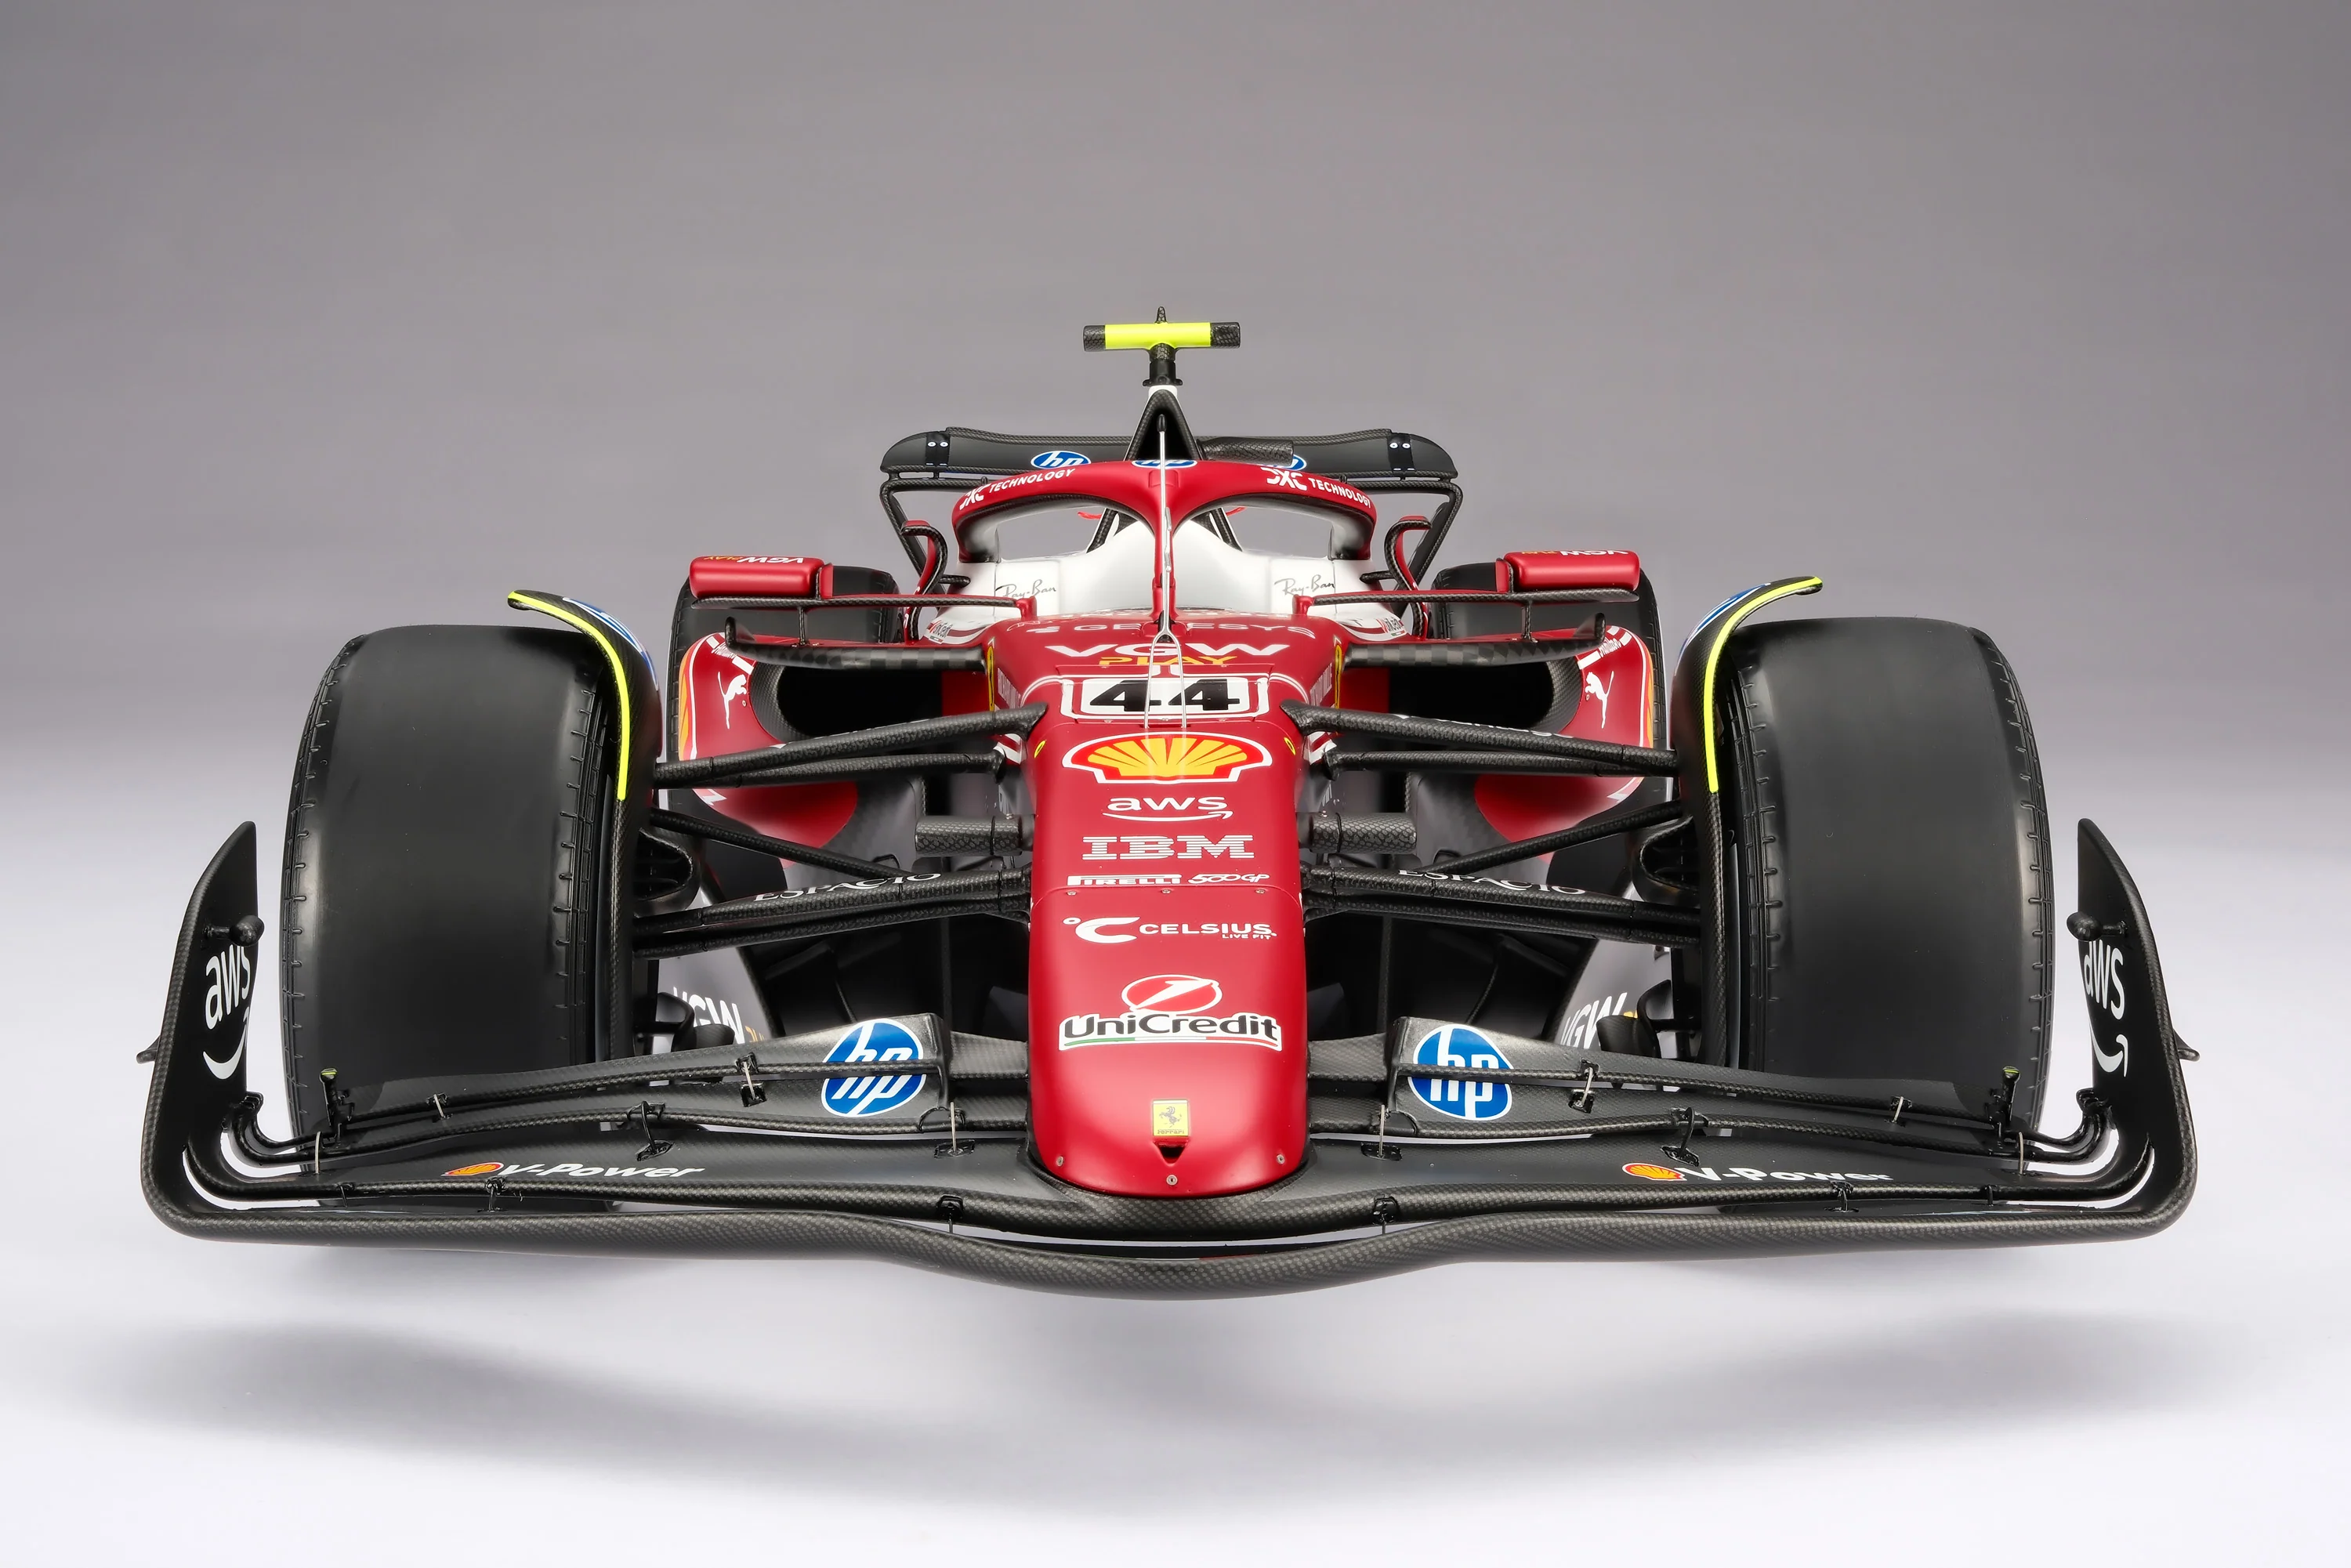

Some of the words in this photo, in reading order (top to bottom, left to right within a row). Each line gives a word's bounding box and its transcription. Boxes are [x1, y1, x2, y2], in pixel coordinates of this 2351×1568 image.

[989, 468, 1075, 494] TECHNOLOGY
[1308, 477, 1371, 509] TECHNOLOGY
[995, 578, 1057, 598] Ray-Ban
[1274, 574, 1335, 596] Ray-Ban
[1045, 643, 1290, 657] VGW
[1099, 656, 1237, 665] PLAY
[1089, 679, 1241, 712] 44
[1107, 796, 1228, 812] aws
[1081, 835, 1255, 860] IBM
[1067, 874, 1183, 886] PIRELLI
[1139, 923, 1273, 936] CELSIUS
[205, 944, 251, 1030] aws
[2084, 939, 2125, 1020] aws
[1064, 1013, 1278, 1041] UniCredit
[829, 1020, 916, 1117] hp
[1427, 1025, 1503, 1120] hp
[498, 1163, 706, 1177] V-Power
[1675, 1167, 1894, 1181] V-Power
